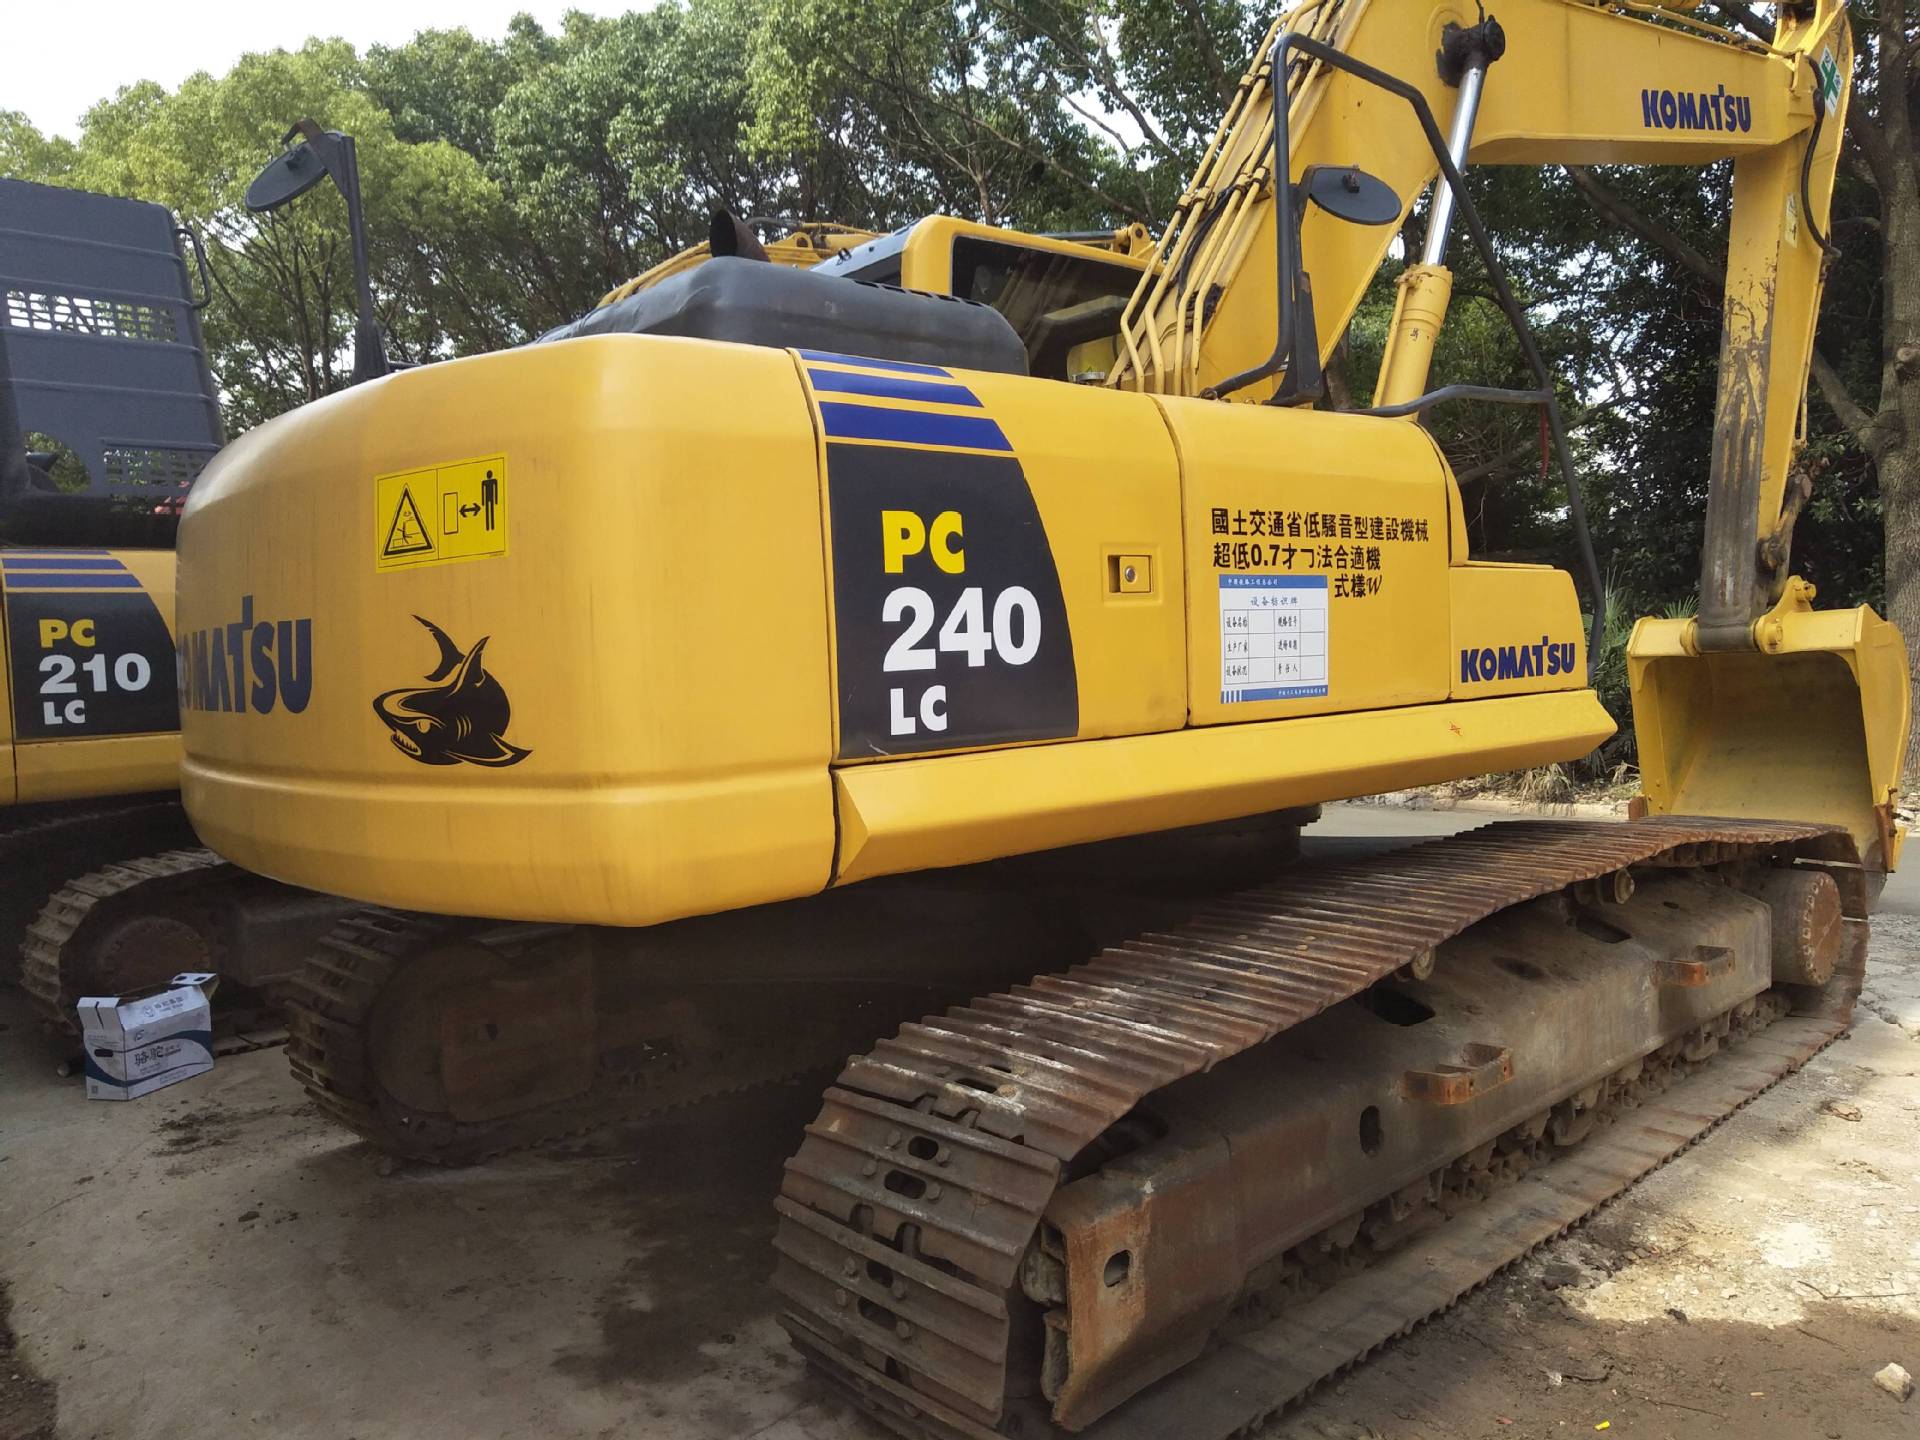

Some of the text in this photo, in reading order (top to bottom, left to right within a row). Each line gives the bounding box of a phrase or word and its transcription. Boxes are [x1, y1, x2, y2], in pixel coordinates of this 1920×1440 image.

[1641, 84, 1751, 133] KOMATSU
[881, 510, 965, 574] PC
[39, 619, 96, 648] PC
[882, 586, 1041, 672] 240
[39, 653, 151, 694] 210
[1461, 635, 1575, 683] KOMATSU
[43, 699, 86, 725] LC
[890, 685, 947, 735] LC
